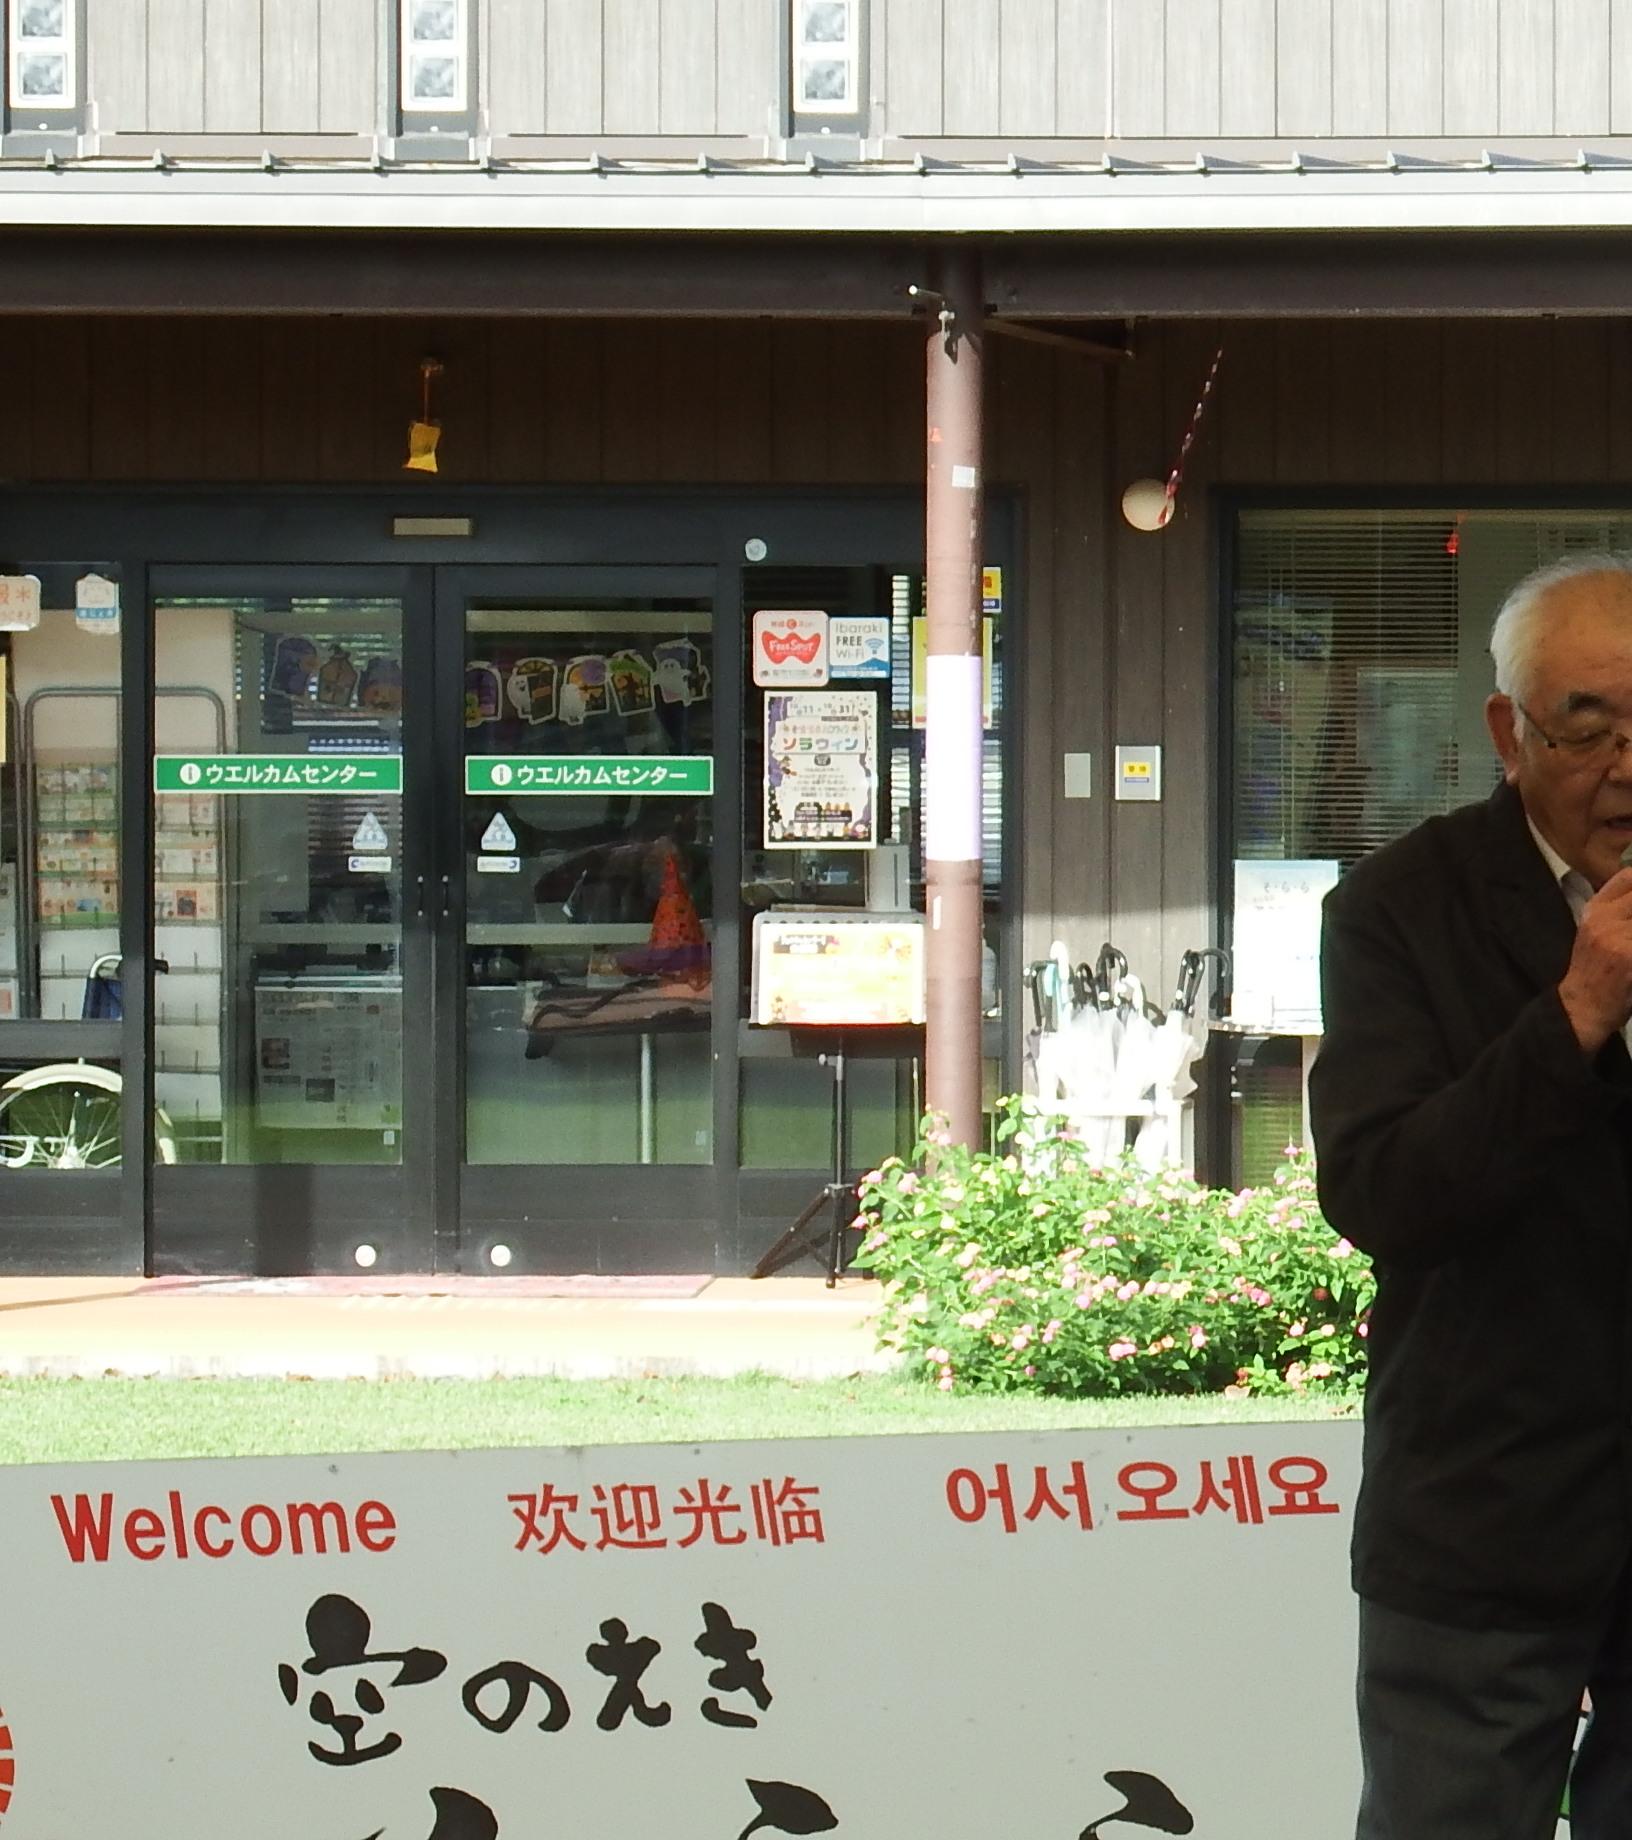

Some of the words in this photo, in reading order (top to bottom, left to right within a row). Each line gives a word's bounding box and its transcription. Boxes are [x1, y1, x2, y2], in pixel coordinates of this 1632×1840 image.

[836, 636, 862, 646] FREE
[206, 764, 377, 784] ウエルカムセンター
[517, 765, 688, 785] ウエルカムセンター
[52, 1492, 397, 1563] Welcome
[508, 1477, 825, 1554] 欢迎光临
[947, 1462, 1091, 1533] 어서
[1119, 1456, 1339, 1524] 오세요
[278, 1593, 773, 1767] 空のえき
